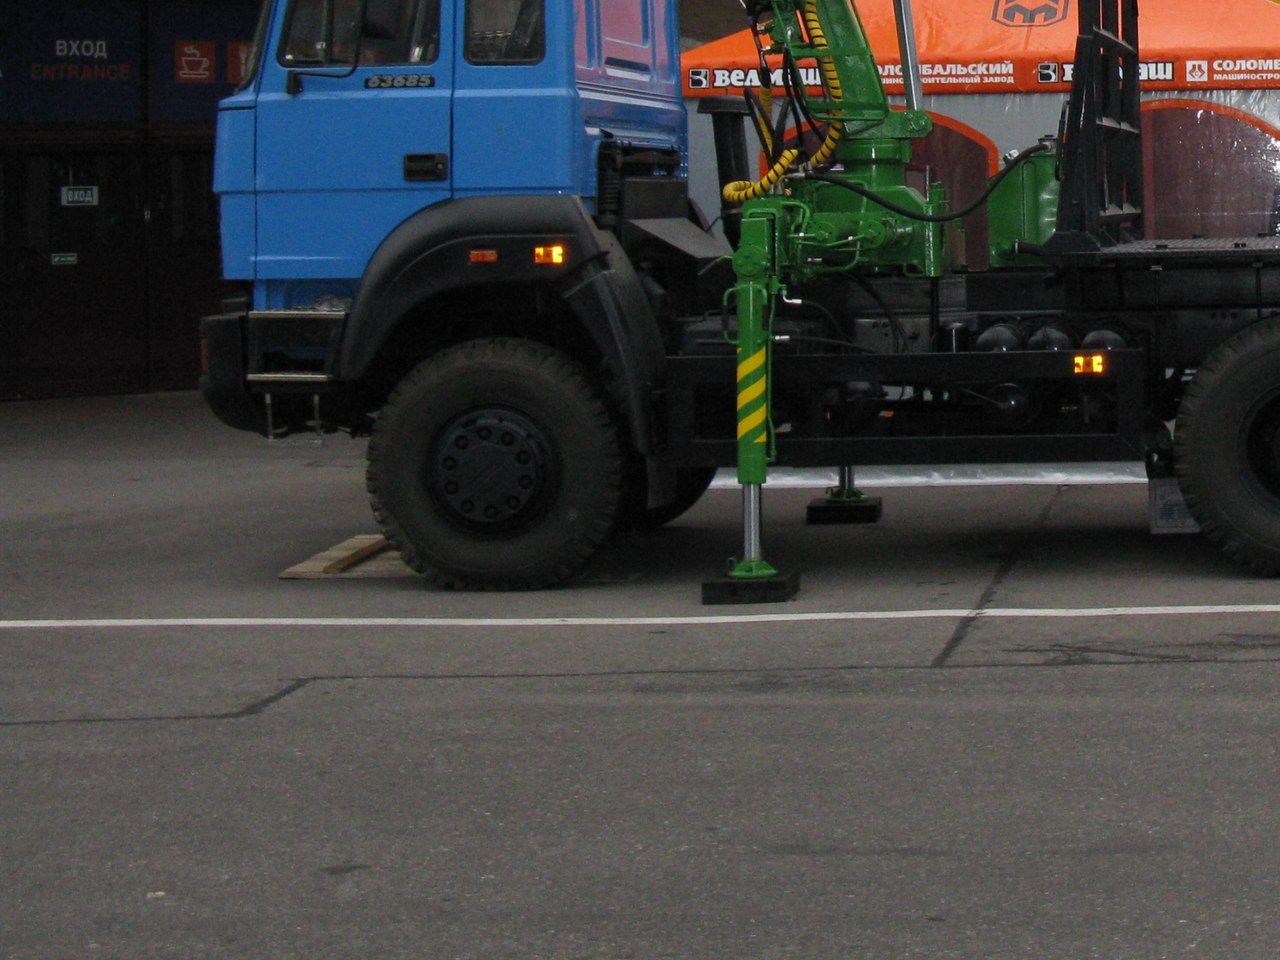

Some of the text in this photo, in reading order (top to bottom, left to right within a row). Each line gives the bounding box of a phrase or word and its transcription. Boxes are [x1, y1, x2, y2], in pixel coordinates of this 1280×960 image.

[56, 40, 107, 58] ВХОД
[30, 64, 131, 81] ENTRANCE
[982, 74, 1015, 84] ЗАВОД
[368, 74, 431, 88] 63685
[67, 189, 93, 203] ВХОД
